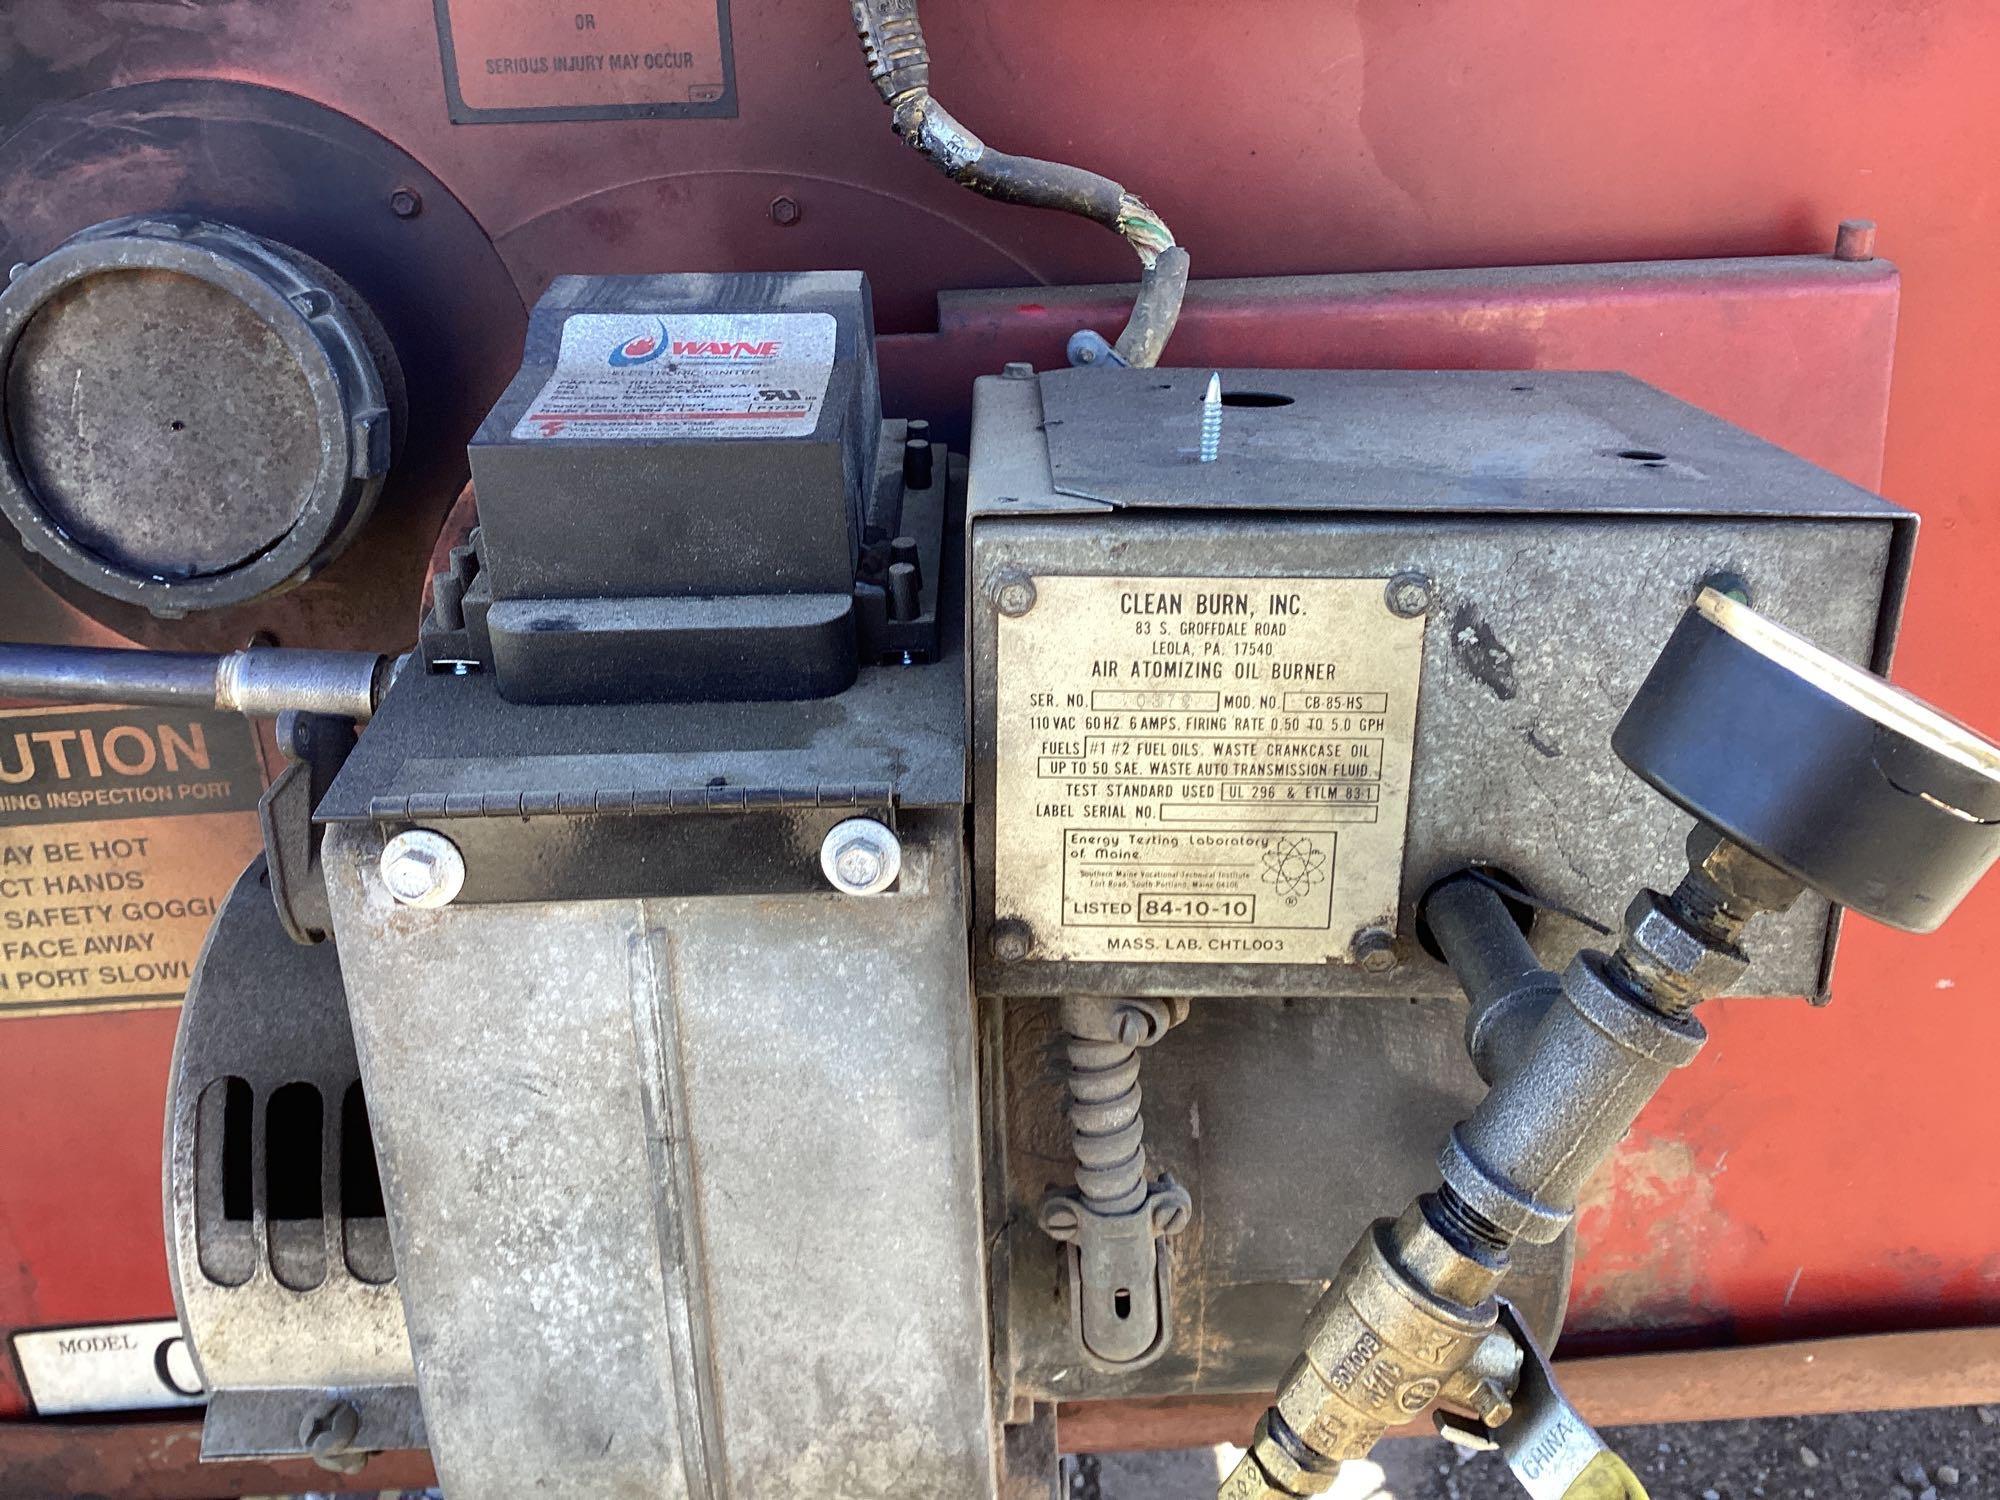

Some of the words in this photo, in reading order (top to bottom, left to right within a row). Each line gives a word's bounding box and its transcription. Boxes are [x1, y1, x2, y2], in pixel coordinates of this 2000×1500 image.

[575, 14, 596, 31] OR
[486, 58, 549, 74] SERIOUS
[553, 55, 604, 73] INJURY
[609, 54, 640, 71] MAY
[644, 52, 694, 70] OCCUR
[672, 341, 783, 360] WAYNE
[1120, 593, 1183, 615] CLEAN
[1196, 593, 1255, 619] BURN,
[1269, 594, 1307, 616] INC.
[1135, 621, 1151, 636] 83
[1159, 622, 1171, 636] S.
[1180, 622, 1248, 636] GROFFDALE
[1254, 623, 1287, 636] ROAD
[1152, 641, 1194, 657] LEOLA,
[1204, 642, 1225, 656] PA.
[1234, 642, 1273, 656] 17540
[1091, 661, 1119, 677] AIR
[1130, 661, 1222, 679] ATOMIZING
[1235, 662, 1259, 679] OIL
[1271, 663, 1336, 680] BURNER
[1030, 693, 1059, 707] SER.
[1067, 694, 1088, 707] NO.
[1224, 695, 1255, 710] MOD.
[1260, 696, 1281, 710] NO.
[1030, 716, 1050, 730] 110
[1053, 716, 1076, 730] VAC
[1085, 717, 1101, 730] 60
[1103, 717, 1120, 730] HZ
[1129, 717, 1137, 730] 6
[1186, 717, 1226, 731] FIRING
[1234, 717, 1265, 731] RATE
[1271, 718, 1299, 731] 0.50
[1307, 718, 1323, 731] TO
[1331, 718, 1351, 731] 5.0
[1359, 719, 1384, 731] GPH
[1042, 741, 1080, 755] FUELS
[1090, 742, 1105, 755] #1
[1111, 742, 1129, 755] #2
[1137, 742, 1167, 755] FUEL
[1213, 743, 1257, 757] WASTE
[1266, 743, 1342, 757] CRANKCASE
[1350, 744, 1370, 758] OIL
[1050, 761, 1066, 774] UP
[1071, 761, 1087, 775] TO
[1093, 761, 1108, 775] 50
[1150, 762, 1191, 776] WASTE
[1197, 762, 1228, 776] AUTO
[1234, 763, 1327, 776] TRANSMISSION
[1333, 763, 1372, 777] FLUID.
[47, 785, 173, 809] INSPECTION
[178, 781, 232, 799] PORT
[1066, 784, 1098, 797] TEST
[1106, 784, 1173, 797] STANDARD
[1182, 785, 1215, 798] USED
[1229, 786, 1244, 798] UL
[1252, 786, 1275, 799] 296
[1287, 787, 1296, 798] &
[1305, 786, 1338, 799] ETLM
[1036, 804, 1075, 818] LABEL
[1083, 804, 1127, 818] SERIAL
[1135, 805, 1156, 819] NO.
[1071, 833, 1120, 847] Energy
[1129, 834, 1179, 846] Testing
[1189, 835, 1270, 848] Laboratory
[43, 841, 84, 863] BE
[91, 837, 149, 860] HOT
[1070, 848, 1084, 859] of
[1095, 849, 1140, 859] Maine
[43, 871, 144, 896] HANDS
[1080, 870, 1113, 878] Southern
[1116, 870, 1137, 878] Maine
[1218, 871, 1250, 880] Institute
[4, 904, 113, 930] SAFETY
[1074, 902, 1132, 915] LISTED
[1145, 900, 1248, 917] 84-10-10
[3, 938, 75, 961] FACE
[83, 933, 155, 956] AWAY
[1107, 938, 1160, 950] MASS.
[1165, 938, 1202, 951] LAB.
[1208, 939, 1284, 951] CHTL003
[16, 966, 89, 990] PORT
[58, 1334, 139, 1355] MODEL
[1521, 1422, 1574, 1481] CHINA
